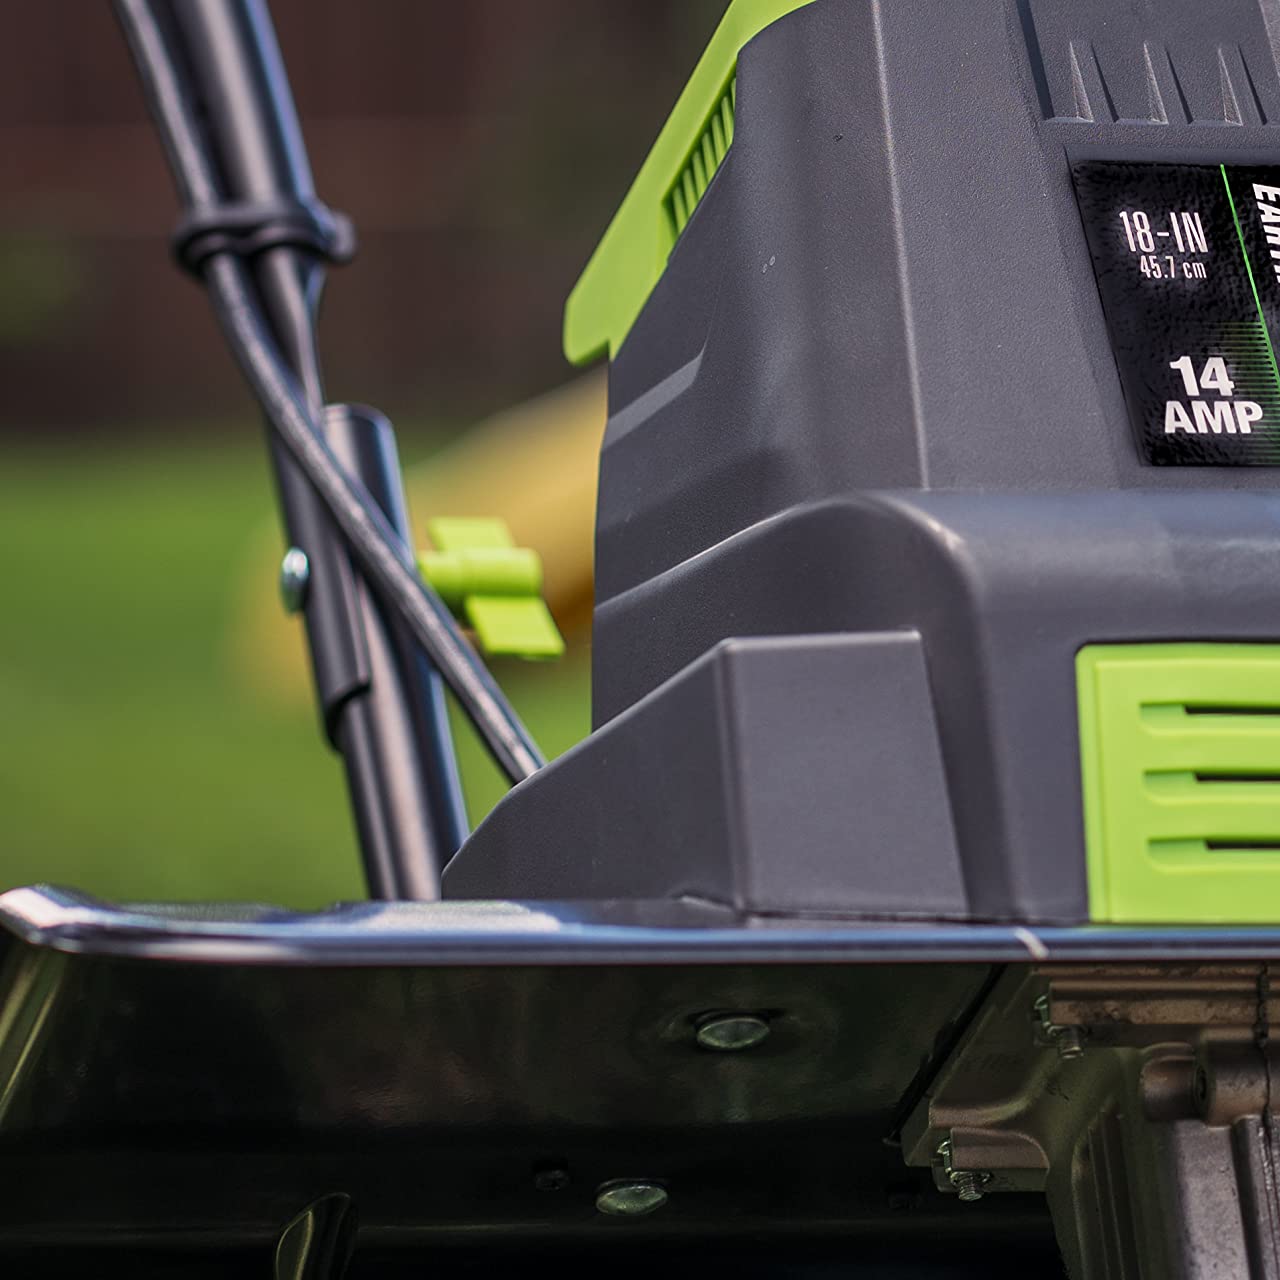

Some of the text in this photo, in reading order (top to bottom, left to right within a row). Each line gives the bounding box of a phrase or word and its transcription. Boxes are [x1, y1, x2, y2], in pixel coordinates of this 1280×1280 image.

[1119, 211, 1209, 253] 18-IN
[1140, 255, 1207, 279] 45.7 cm
[1169, 356, 1235, 397] 14
[1164, 400, 1263, 434] AMP
